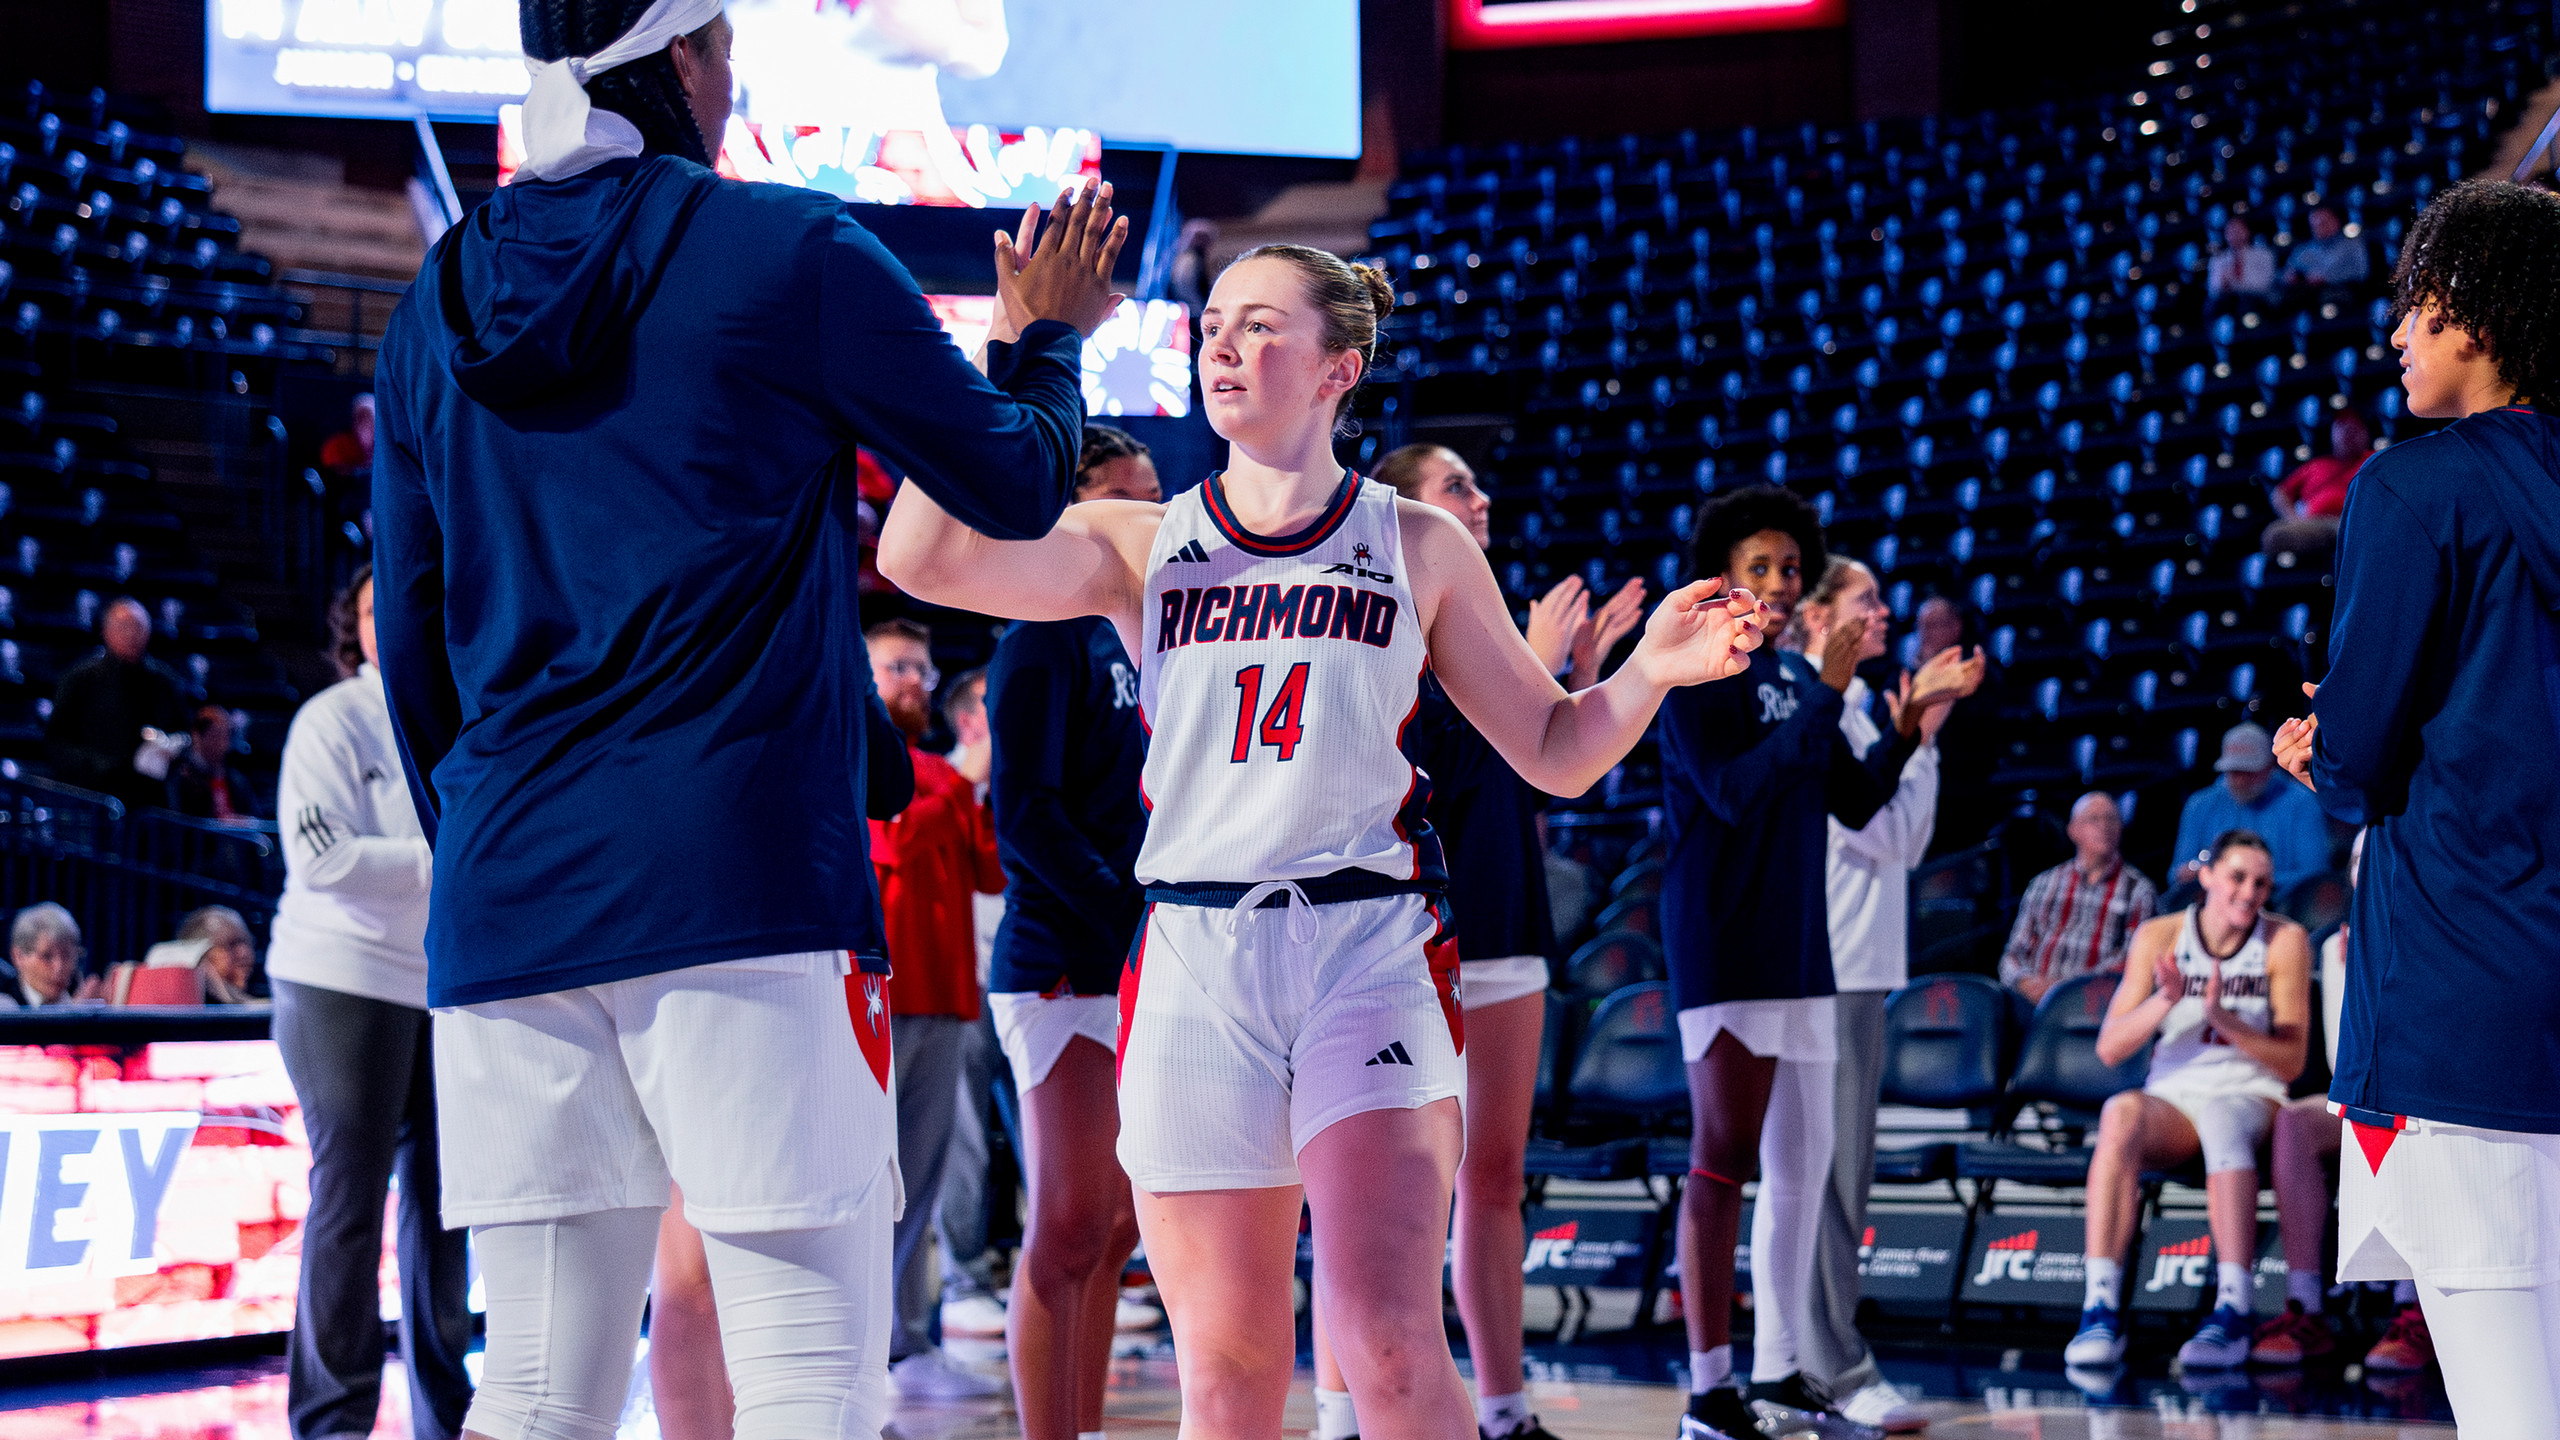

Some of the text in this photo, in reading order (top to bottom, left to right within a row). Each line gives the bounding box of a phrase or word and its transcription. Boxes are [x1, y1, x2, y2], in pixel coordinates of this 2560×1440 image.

[1320, 563, 1394, 584] A10
[1157, 583, 1398, 654] RICHMOND
[1230, 661, 1311, 764] 14
[0, 1127, 194, 1270] EY
[1973, 1249, 2036, 1286] jrc
[2145, 1255, 2210, 1293] jrc
